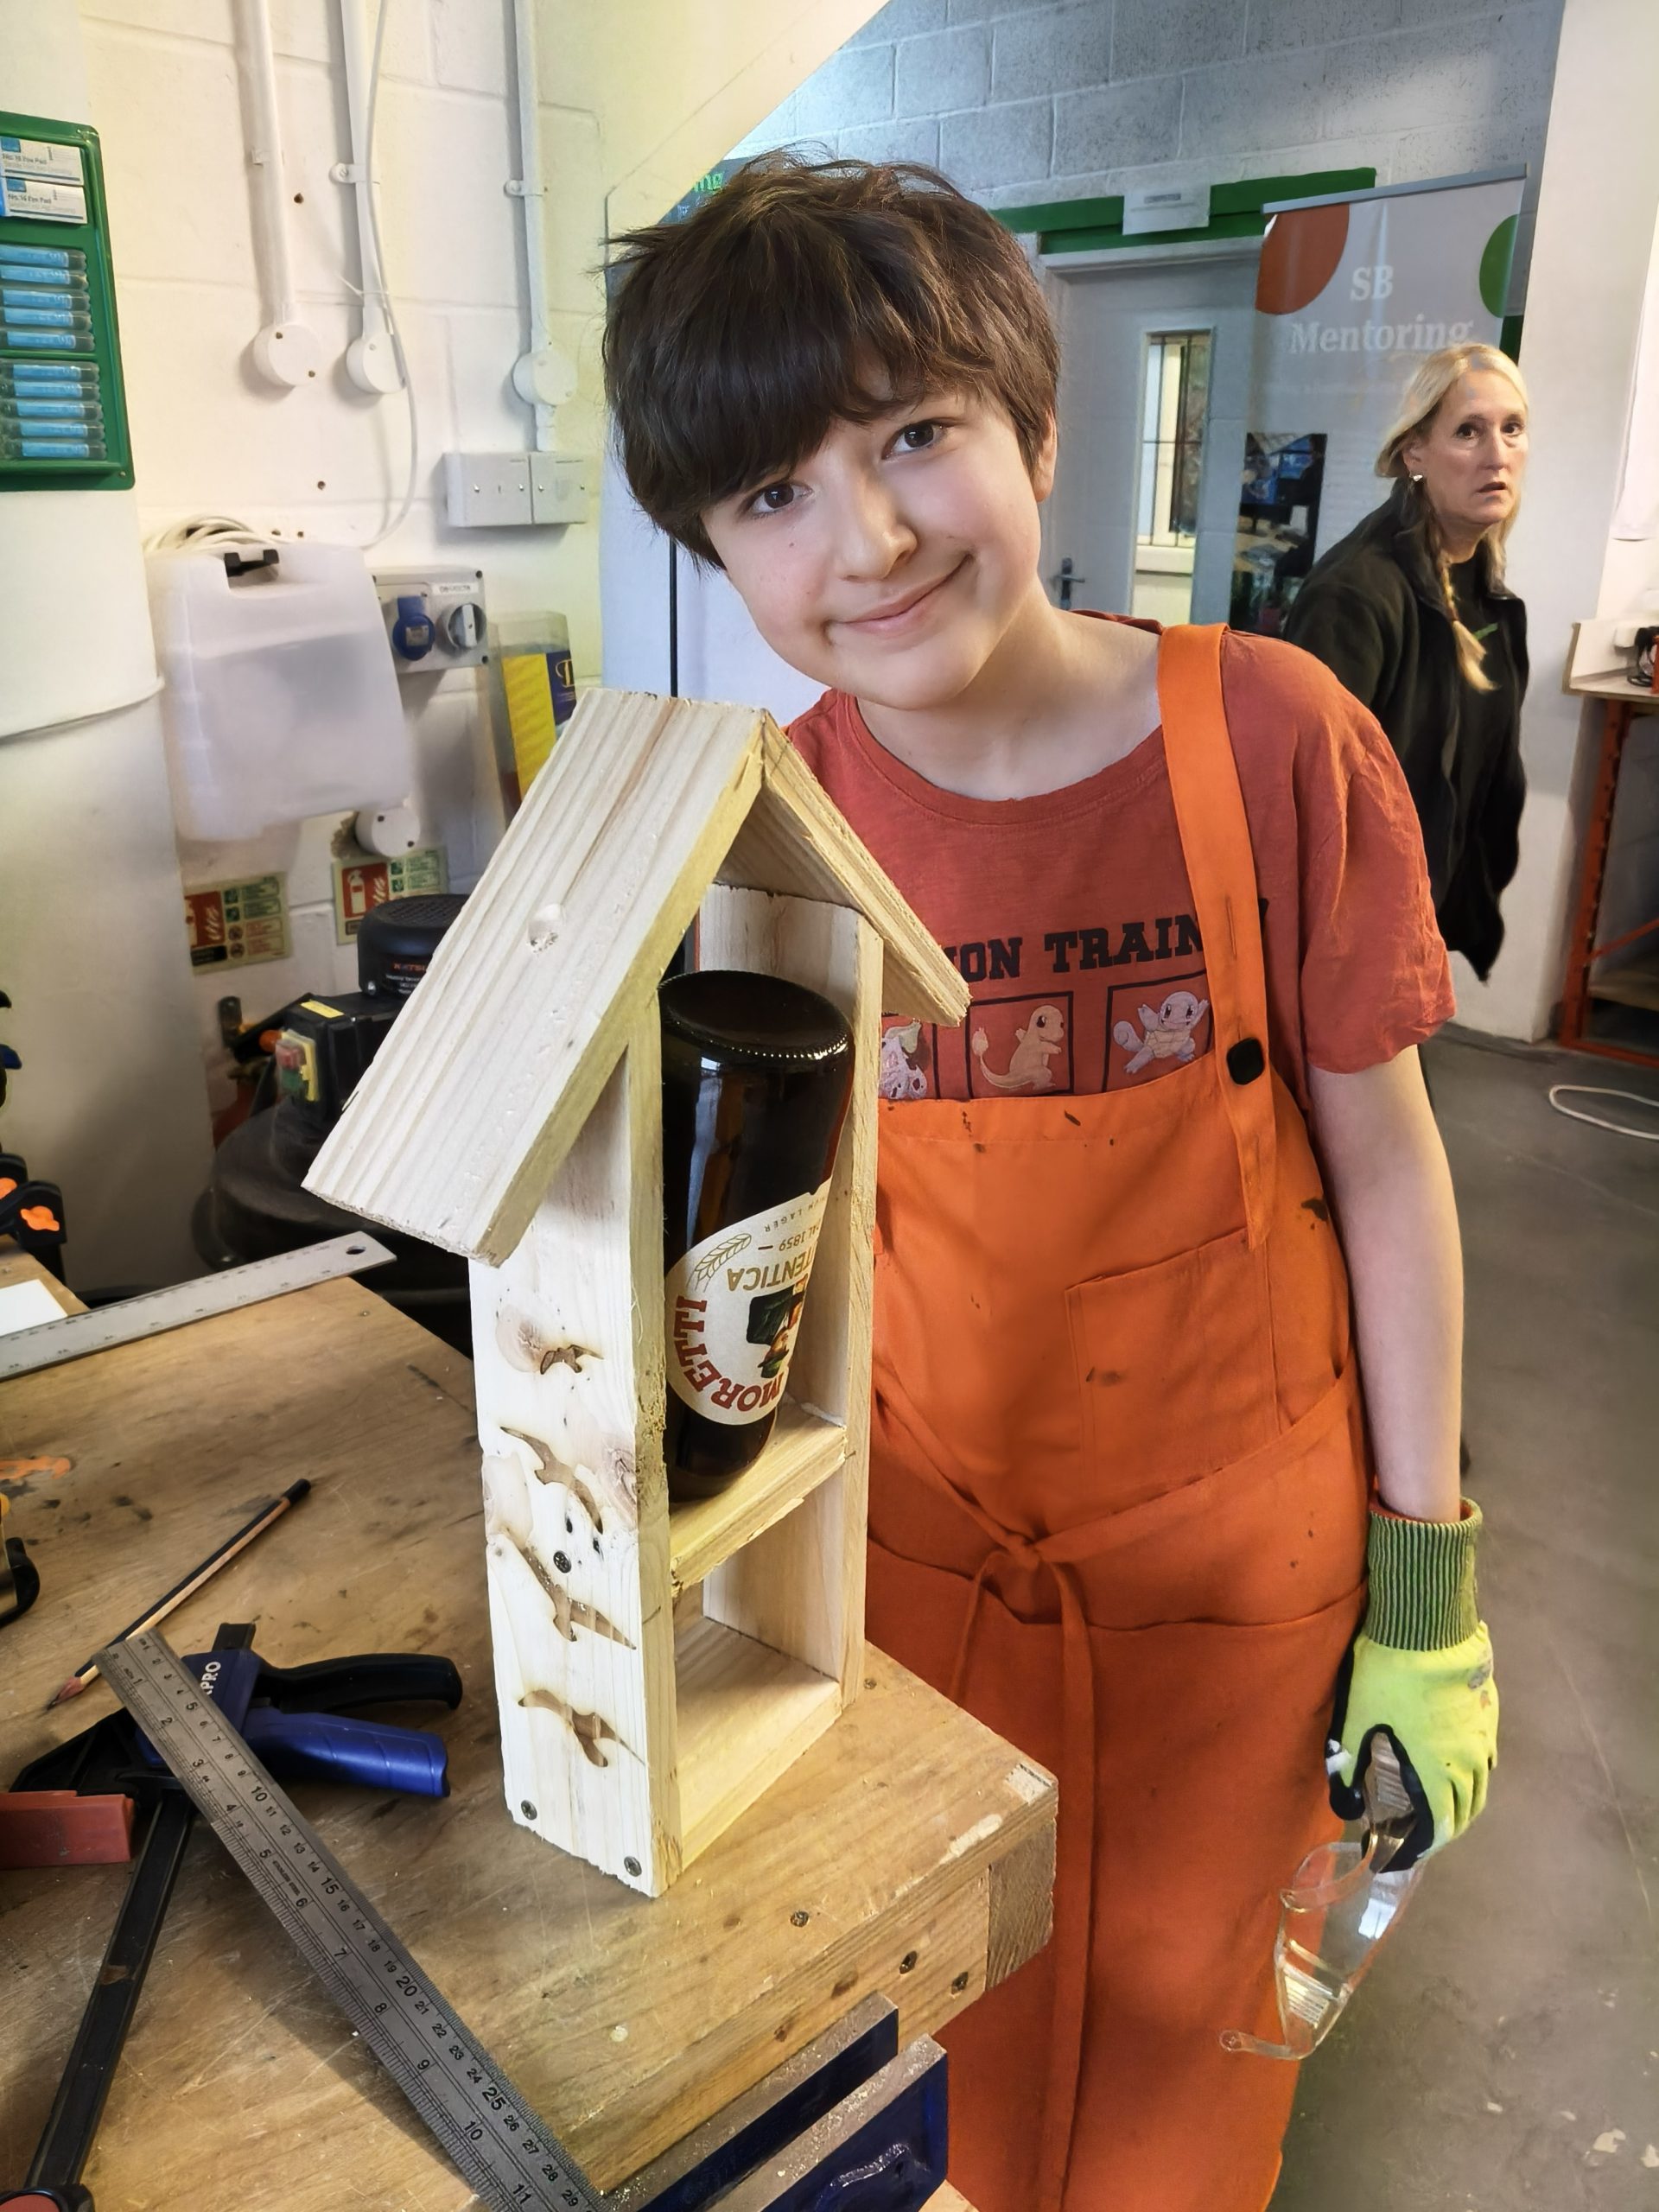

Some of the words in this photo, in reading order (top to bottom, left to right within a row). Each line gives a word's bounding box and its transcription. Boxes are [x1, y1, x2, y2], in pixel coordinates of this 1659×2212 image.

[1350, 264, 1394, 301] SB
[1290, 313, 1474, 354] Mentoring
[764, 1208, 803, 1232] LAGER
[779, 1231, 806, 1251] 1859
[727, 1243, 816, 1292] TENTICA
[673, 1295, 784, 1412] MORETTI
[200, 1661, 221, 1695] PRO
[162, 1717, 173, 1726] 2
[192, 1758, 204, 1768] 3
[259, 1848, 272, 1859] 5
[296, 1897, 308, 1908] 6
[334, 1948, 347, 1957] 7
[374, 2002, 387, 2013] 8
[416, 2059, 430, 2070] 9
[464, 2120, 483, 2140] 10
[512, 2183, 532, 2204] 11
[186, 1701, 198, 1710] 5
[251, 1785, 268, 1802] 10
[265, 1806, 276, 1817] 11
[280, 1824, 292, 1836] 12
[294, 1842, 306, 1854] 13
[308, 1861, 320, 1872] 14
[321, 1877, 340, 1895] 15
[337, 1899, 350, 1912] 16
[353, 1919, 366, 1931] 17
[367, 1939, 380, 1952] 18
[384, 1961, 397, 1973] 19
[396, 1975, 417, 1997] 20
[415, 2000, 429, 2015] 21
[432, 2023, 447, 2038] 22
[448, 2045, 464, 2061] 23
[467, 2068, 483, 2084] 24
[482, 2087, 506, 2110] 25
[503, 2114, 520, 2132] 26
[522, 2139, 540, 2155] 27
[542, 2164, 558, 2182] 28
[562, 2189, 579, 2207] 29
